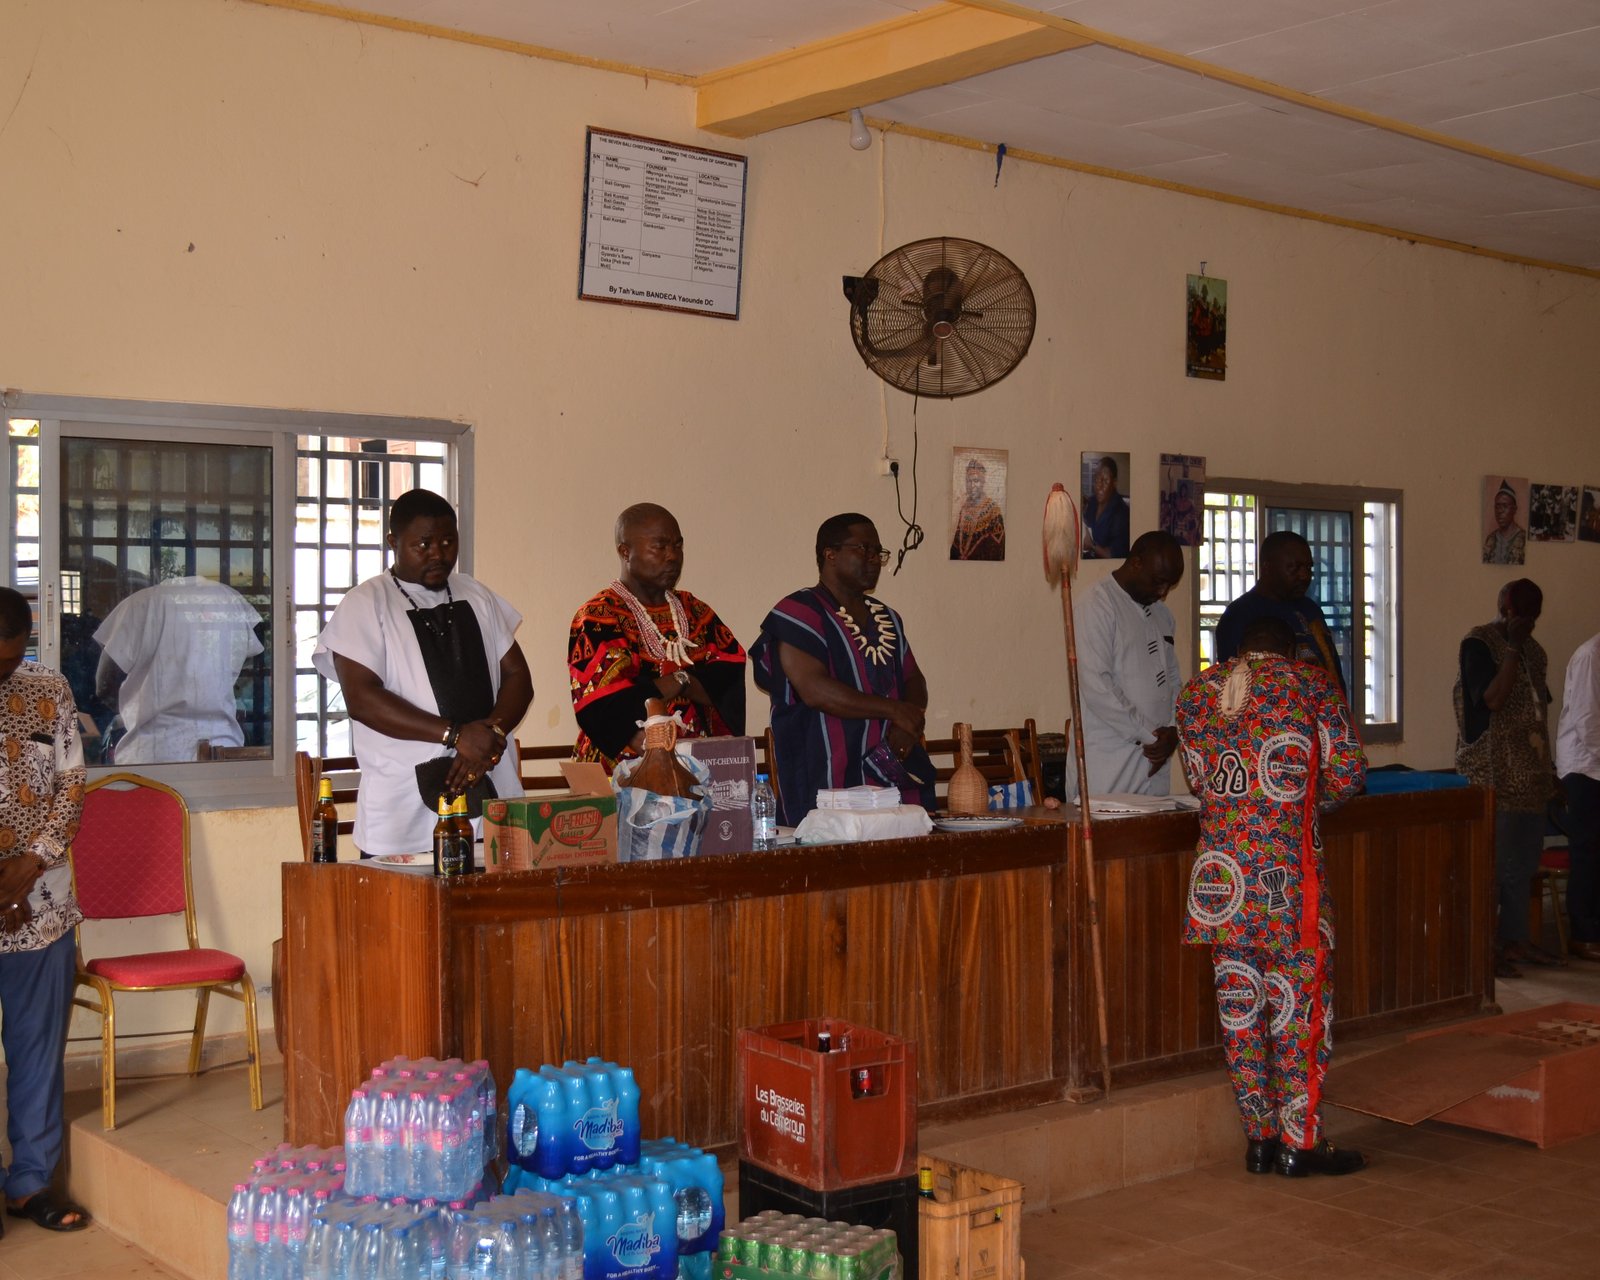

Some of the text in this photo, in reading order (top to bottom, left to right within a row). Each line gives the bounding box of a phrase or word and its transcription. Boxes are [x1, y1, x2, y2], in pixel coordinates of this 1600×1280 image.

[656, 148, 679, 156] FOLLOWING
[614, 163, 630, 171] Nyonga
[646, 163, 666, 171] FOUNDER
[698, 173, 719, 181] LOCATION
[695, 236, 710, 244] Nyonga
[608, 284, 617, 294] By
[645, 290, 676, 301] BANDECA
[676, 295, 703, 305] Yaounde
[704, 298, 714, 306] DC
[1272, 736, 1310, 750] BALI NYONGA
[1272, 763, 1304, 773] BANDECA
[1200, 855, 1233, 868] BALI NYONGA
[1198, 884, 1229, 893] BANDECA
[1197, 911, 1208, 921] AND
[1208, 910, 1232, 923] CULTURAL
[1230, 870, 1242, 911] ASSOCIATION
[756, 1084, 806, 1117] Les Brasseries
[760, 1107, 806, 1137] du Cameroun
[574, 1118, 623, 1139] Madiba
[606, 1232, 660, 1257] Madiba
[622, 1267, 643, 1276] HEALTHY
